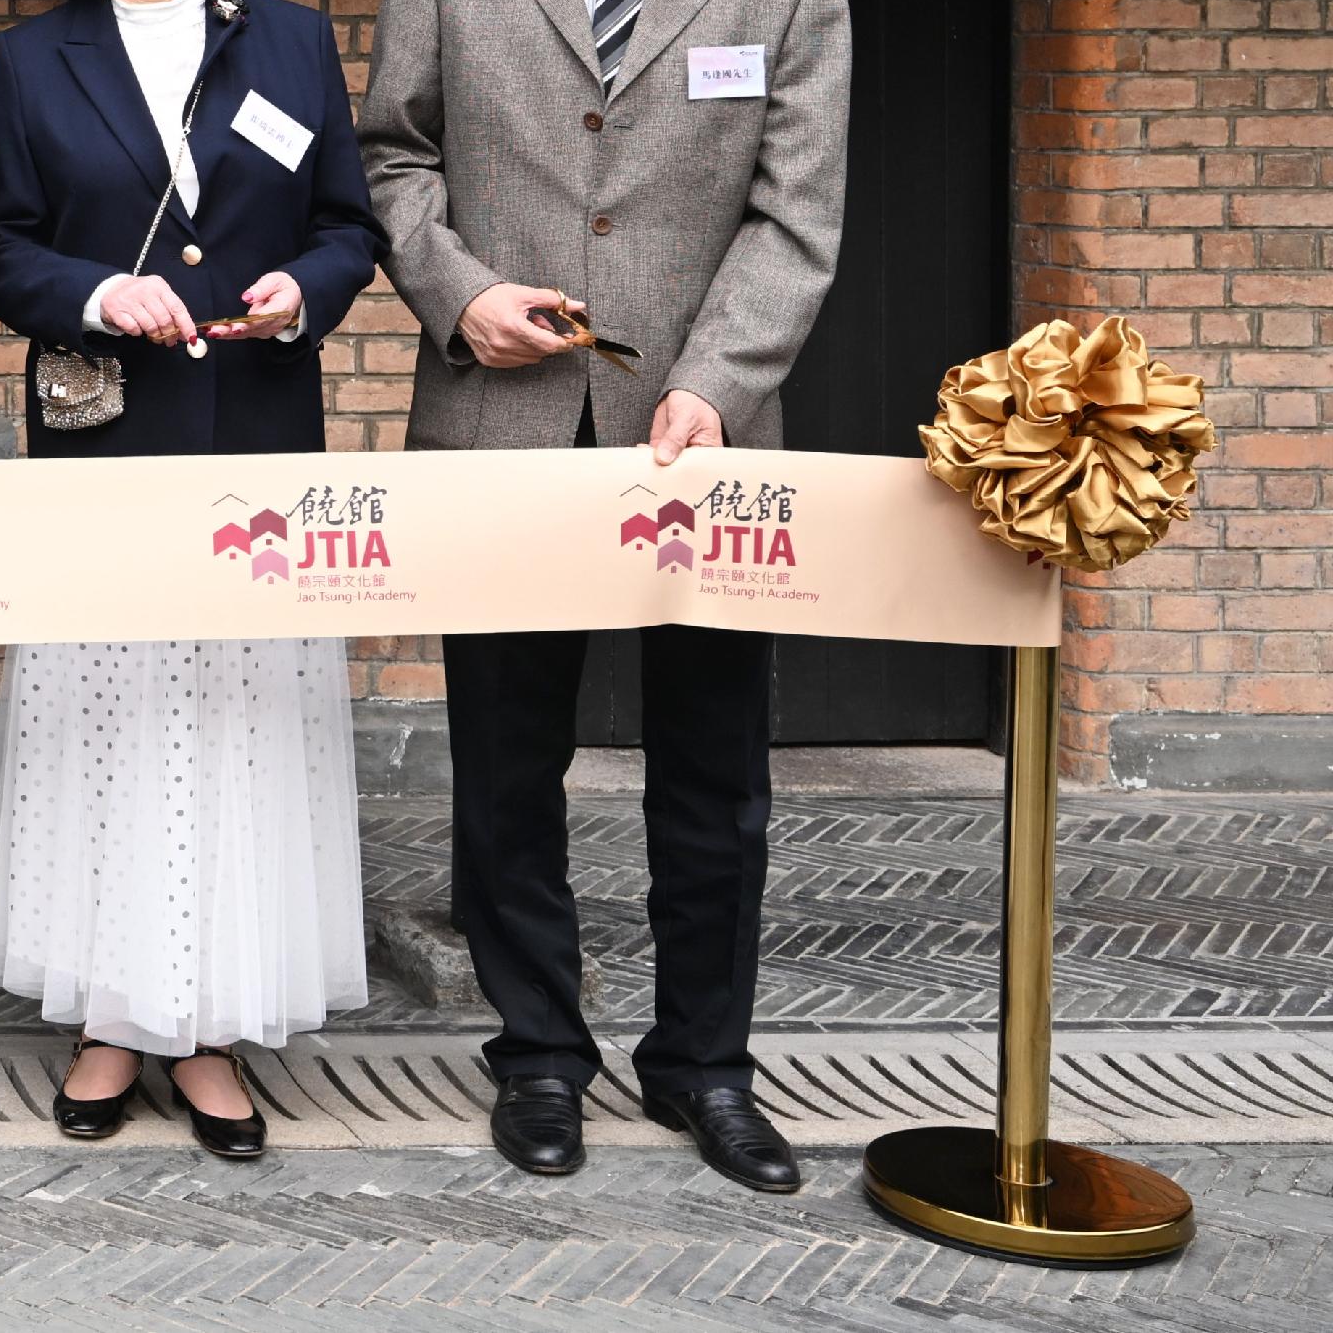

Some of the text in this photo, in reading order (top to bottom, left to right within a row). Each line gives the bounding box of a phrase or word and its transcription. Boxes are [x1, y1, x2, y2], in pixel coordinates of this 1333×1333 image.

[296, 530, 391, 569] JTIA
[702, 525, 797, 566] JTIA
[296, 592, 316, 603] Jao
[363, 590, 417, 602] Academy
[699, 584, 719, 595] Jao
[767, 586, 820, 603] Academy
